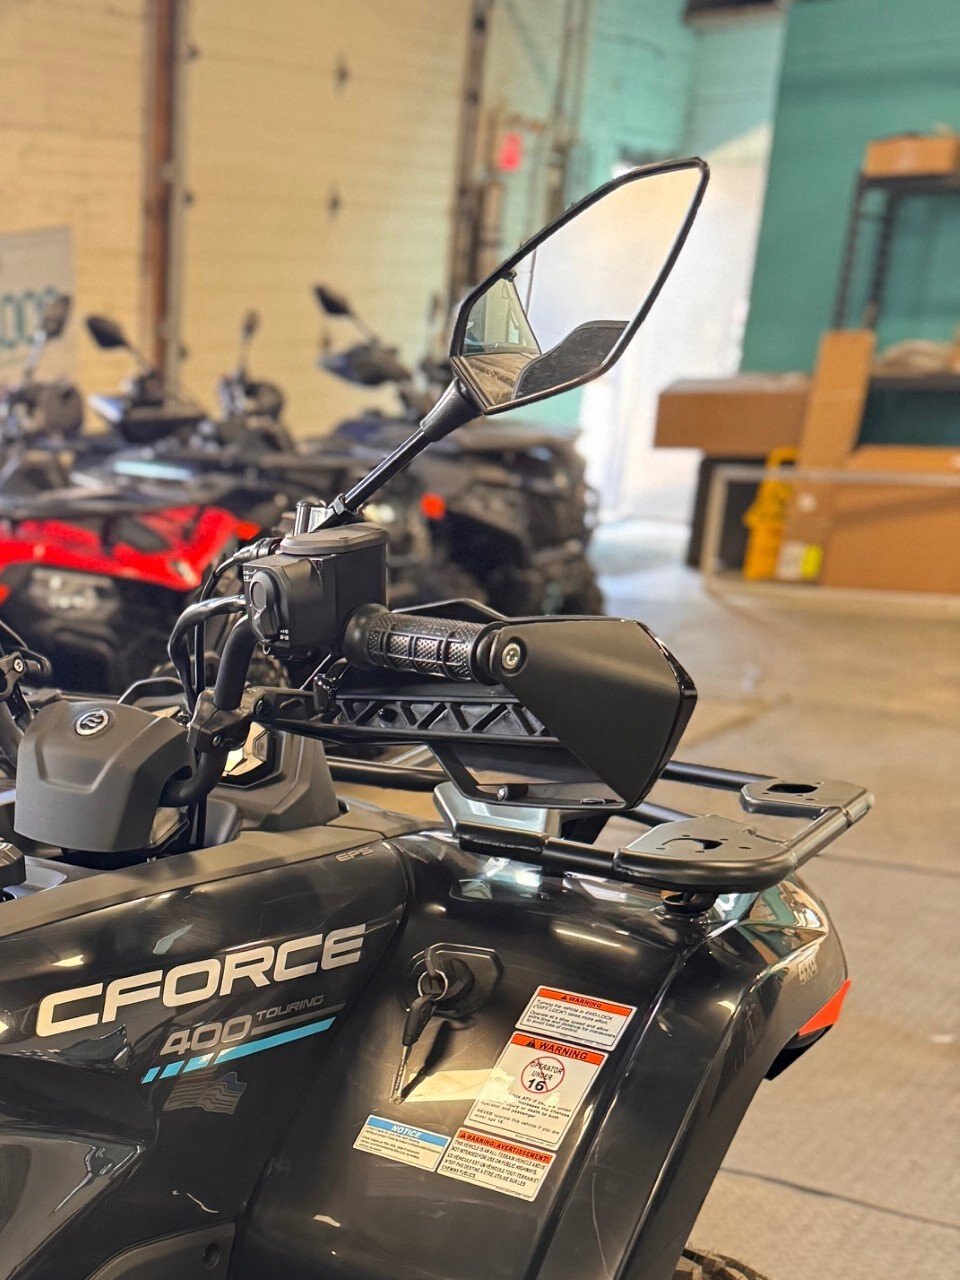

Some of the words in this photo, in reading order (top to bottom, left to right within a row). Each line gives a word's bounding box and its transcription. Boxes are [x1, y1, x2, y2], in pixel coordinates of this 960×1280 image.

[334, 846, 374, 862] EPS
[35, 923, 366, 1038] CFORCE
[255, 995, 325, 1022] TOURING
[569, 996, 602, 1008] WARNING
[158, 1014, 255, 1056] 400
[539, 1041, 589, 1060] WARNING
[530, 1061, 564, 1074] OPERATOR
[531, 1070, 553, 1081] UNDER
[527, 1079, 545, 1092] 16
[391, 1125, 422, 1138] NOTICE
